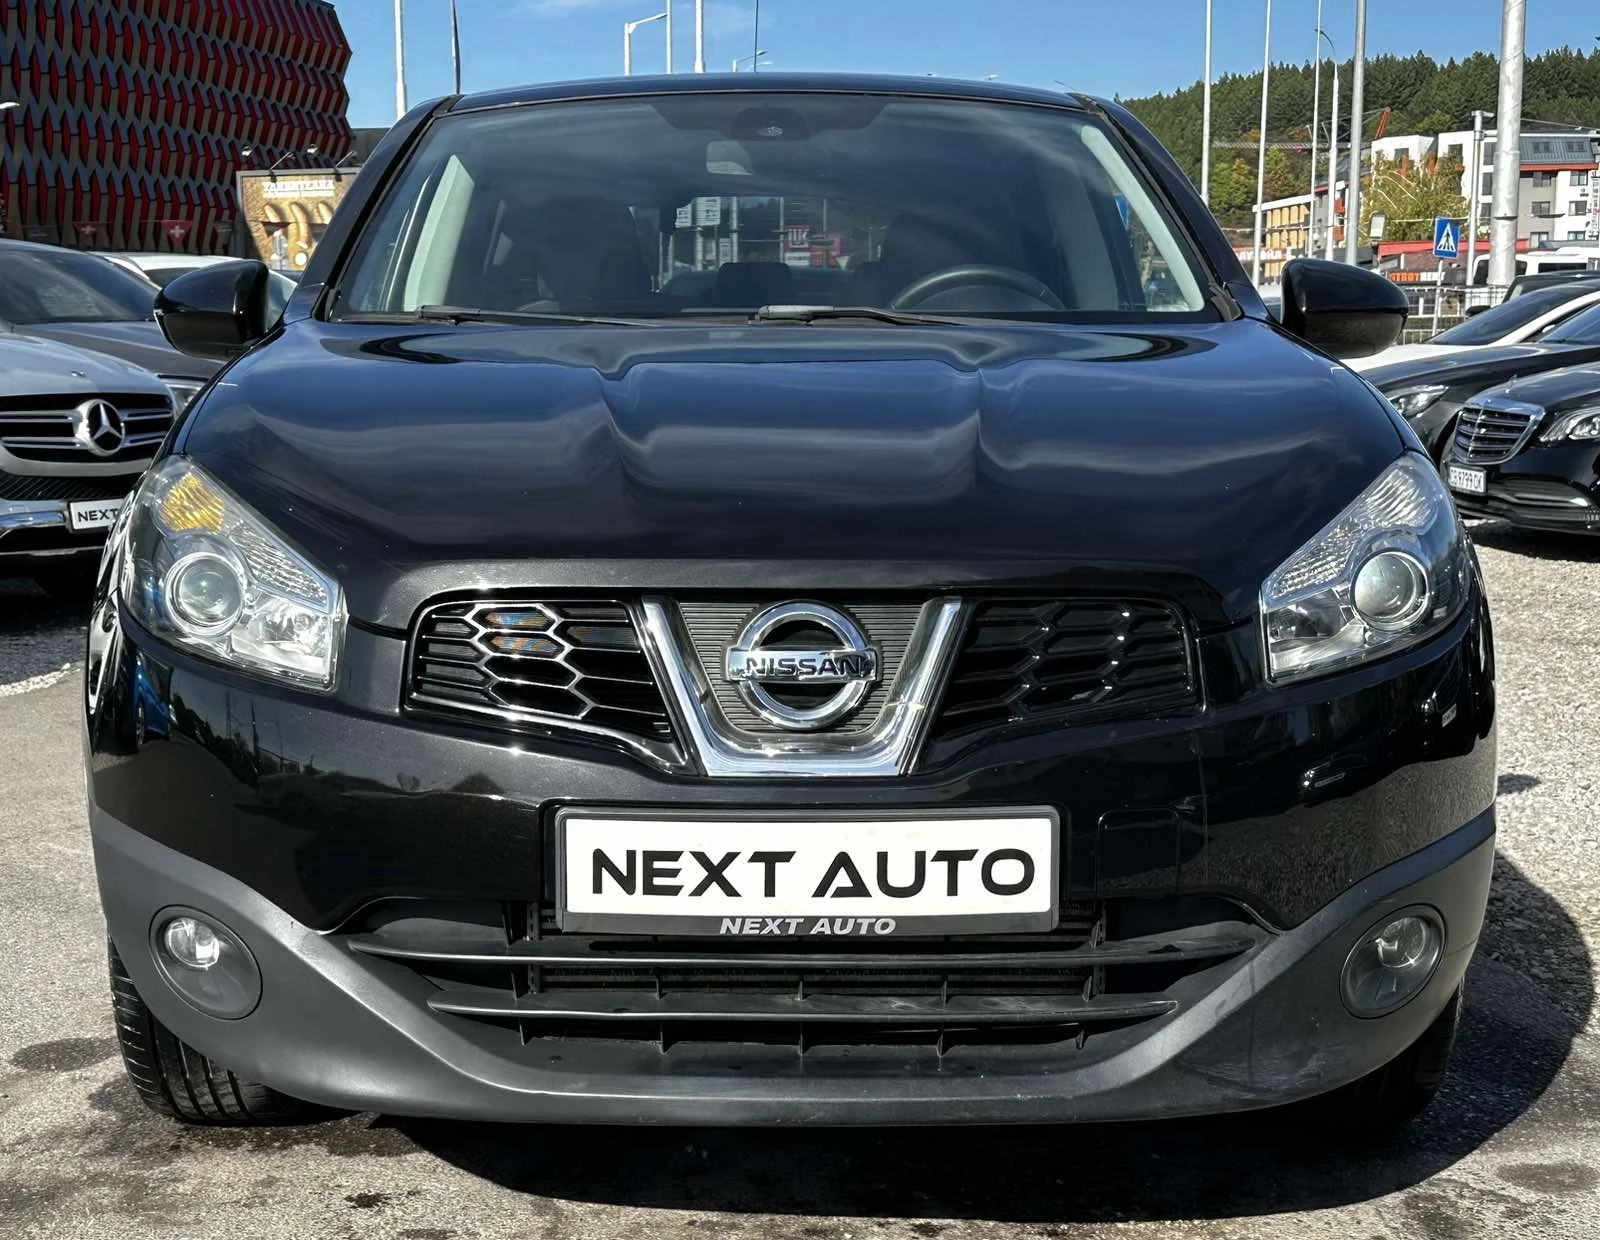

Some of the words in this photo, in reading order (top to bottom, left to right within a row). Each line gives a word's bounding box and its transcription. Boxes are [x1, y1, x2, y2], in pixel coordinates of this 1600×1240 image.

[77, 508, 119, 522] NEXT
[745, 656, 862, 677] NISSAN
[592, 847, 797, 898] NEXT
[811, 847, 1036, 898] AUTO
[719, 917, 805, 936] NEXT
[809, 917, 897, 936] AUTO
